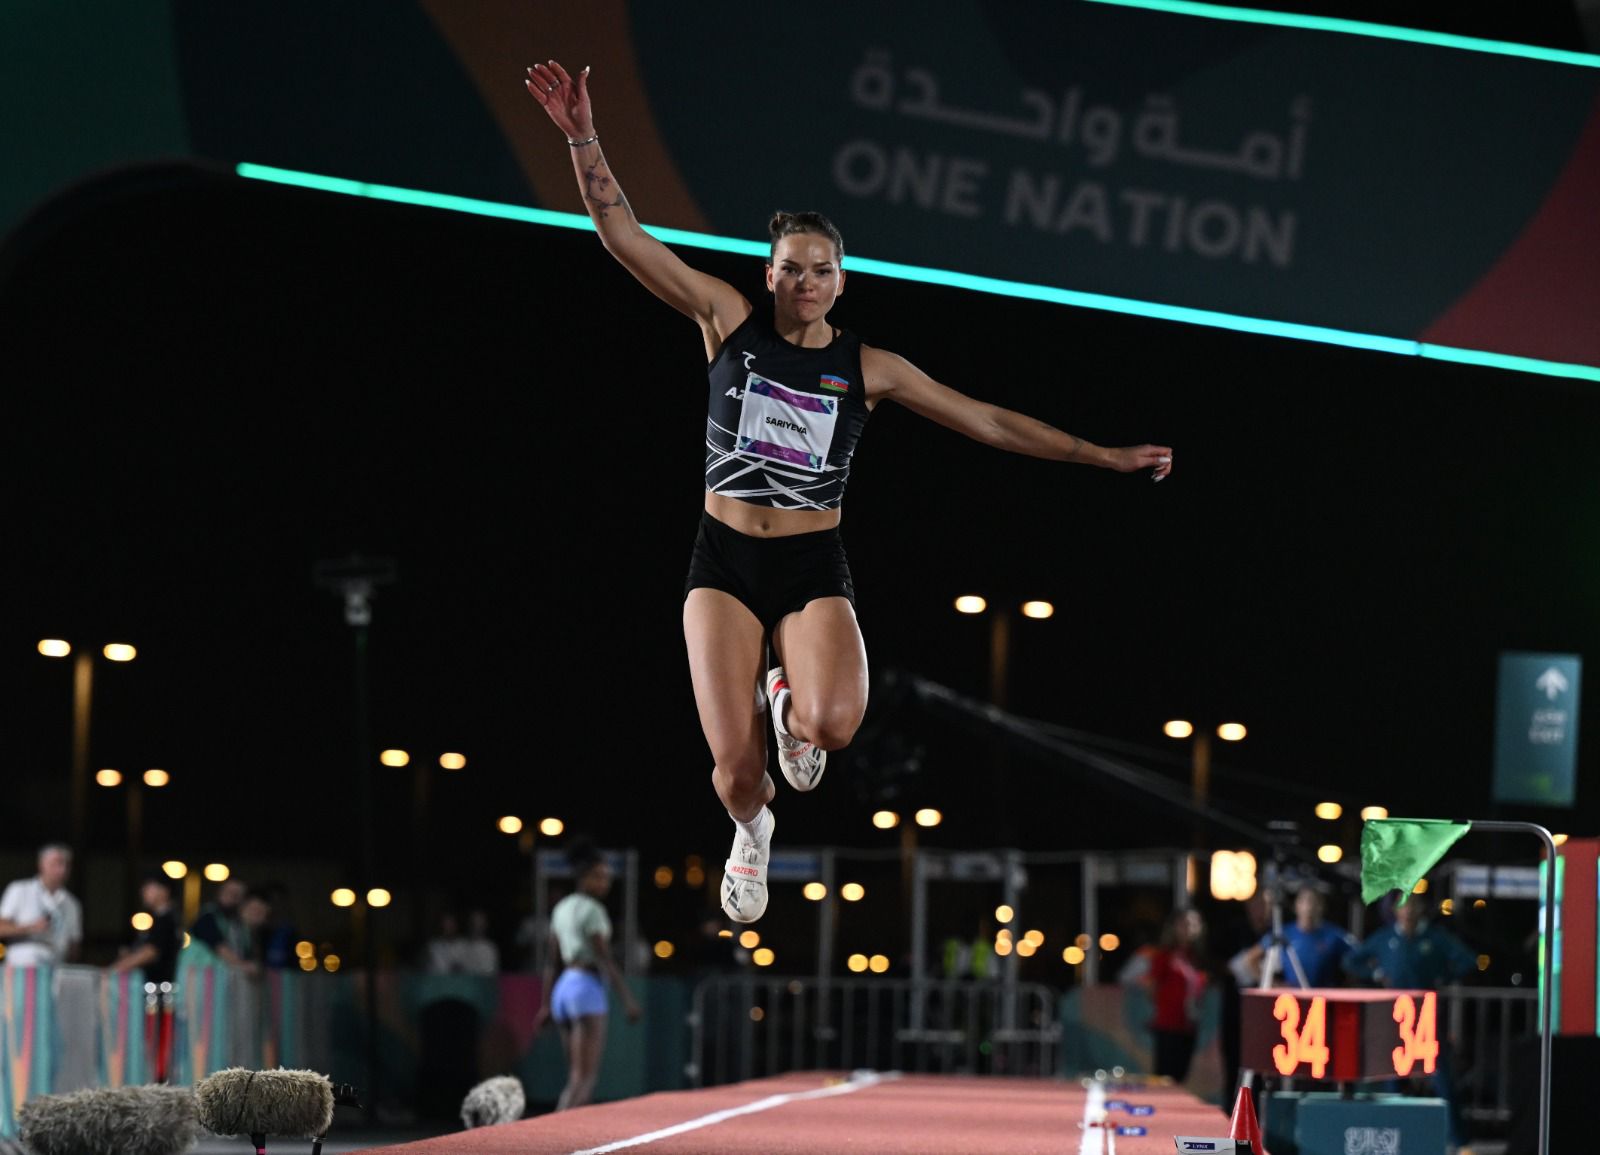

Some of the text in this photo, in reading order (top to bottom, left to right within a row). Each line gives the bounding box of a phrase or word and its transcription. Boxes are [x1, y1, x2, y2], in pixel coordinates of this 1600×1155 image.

[833, 139, 1294, 267] ONE NATION
[765, 416, 807, 435] SARIYEVA
[1273, 993, 1329, 1079] 34
[1392, 991, 1439, 1077] 34
